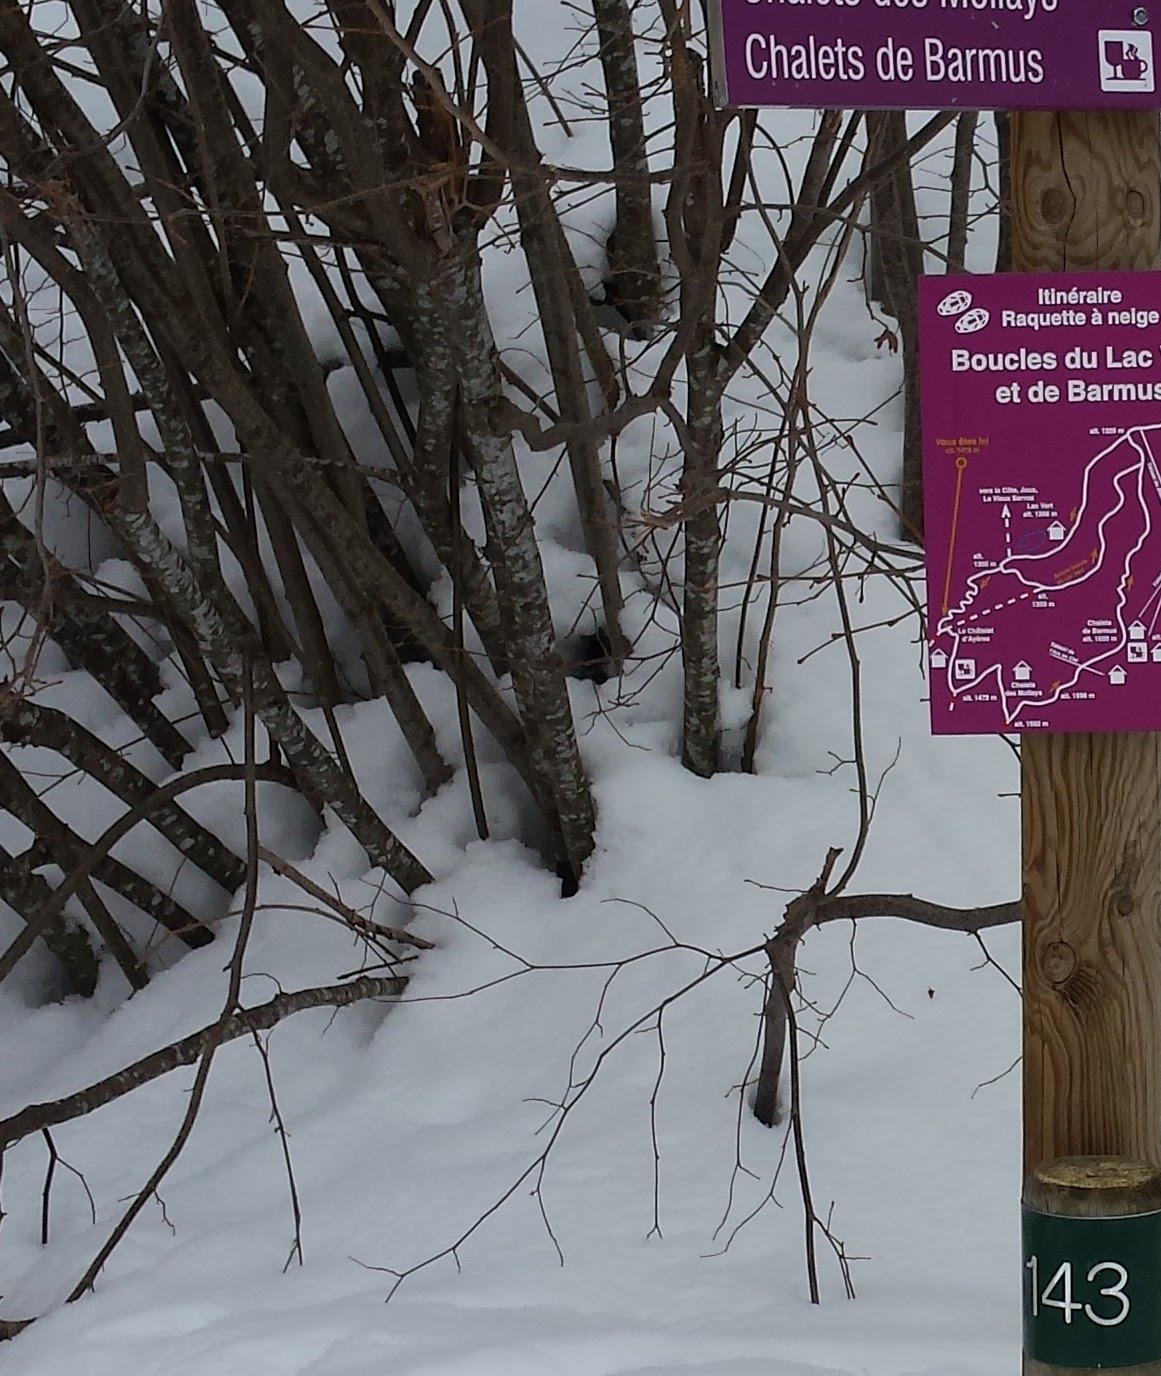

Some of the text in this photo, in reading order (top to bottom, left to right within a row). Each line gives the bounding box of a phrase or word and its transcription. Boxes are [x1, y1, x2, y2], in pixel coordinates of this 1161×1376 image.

[745, 33, 1045, 83] Chalets de Barmus
[1037, 287, 1122, 306] Itinéraire
[1001, 308, 1159, 330] Raquette à neige
[952, 347, 1057, 371] Boucles
[1064, 347, 1098, 369] du
[1106, 346, 1153, 368] Lac
[996, 382, 1021, 403] et
[1027, 381, 1060, 403] de
[1026, 1255, 1130, 1327] 143
